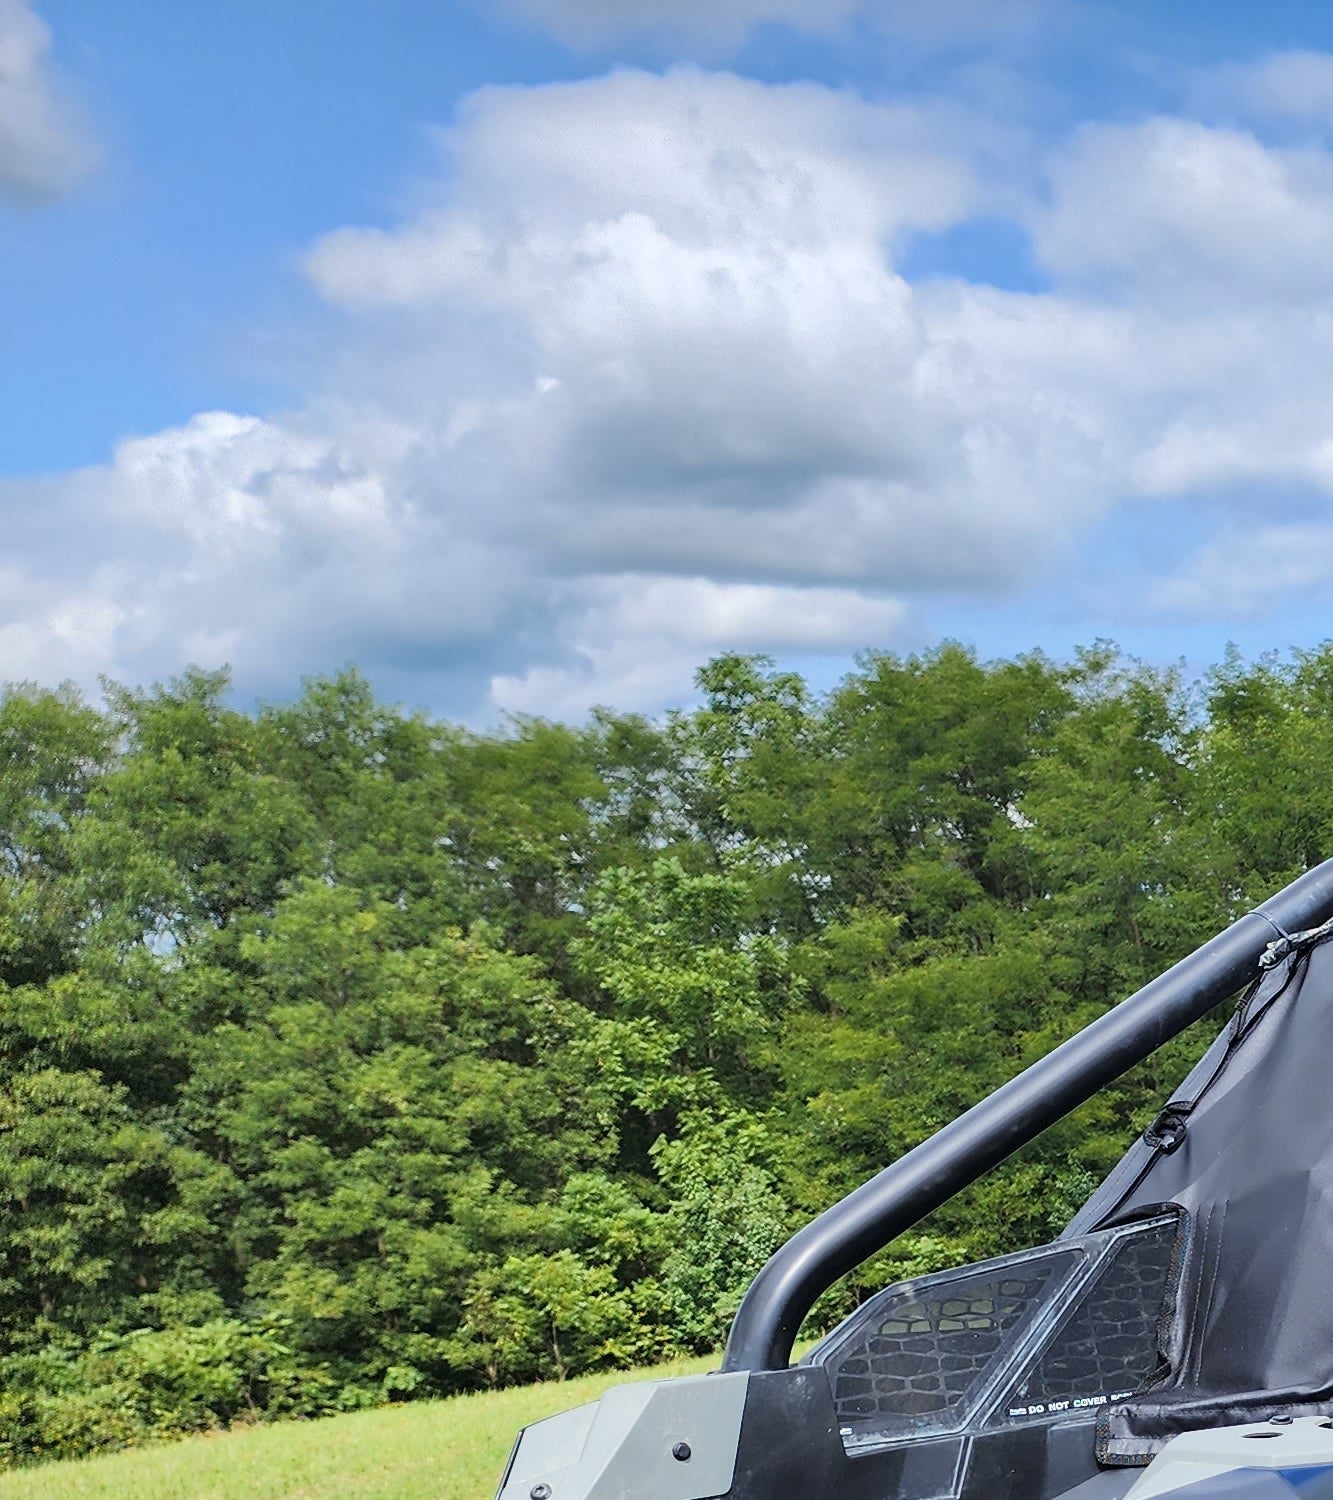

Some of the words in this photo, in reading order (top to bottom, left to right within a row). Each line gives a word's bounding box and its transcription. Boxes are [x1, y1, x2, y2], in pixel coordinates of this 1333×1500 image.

[1028, 1404, 1045, 1415] DO
[1048, 1401, 1070, 1412] NOT
[1073, 1395, 1107, 1408] COVER
